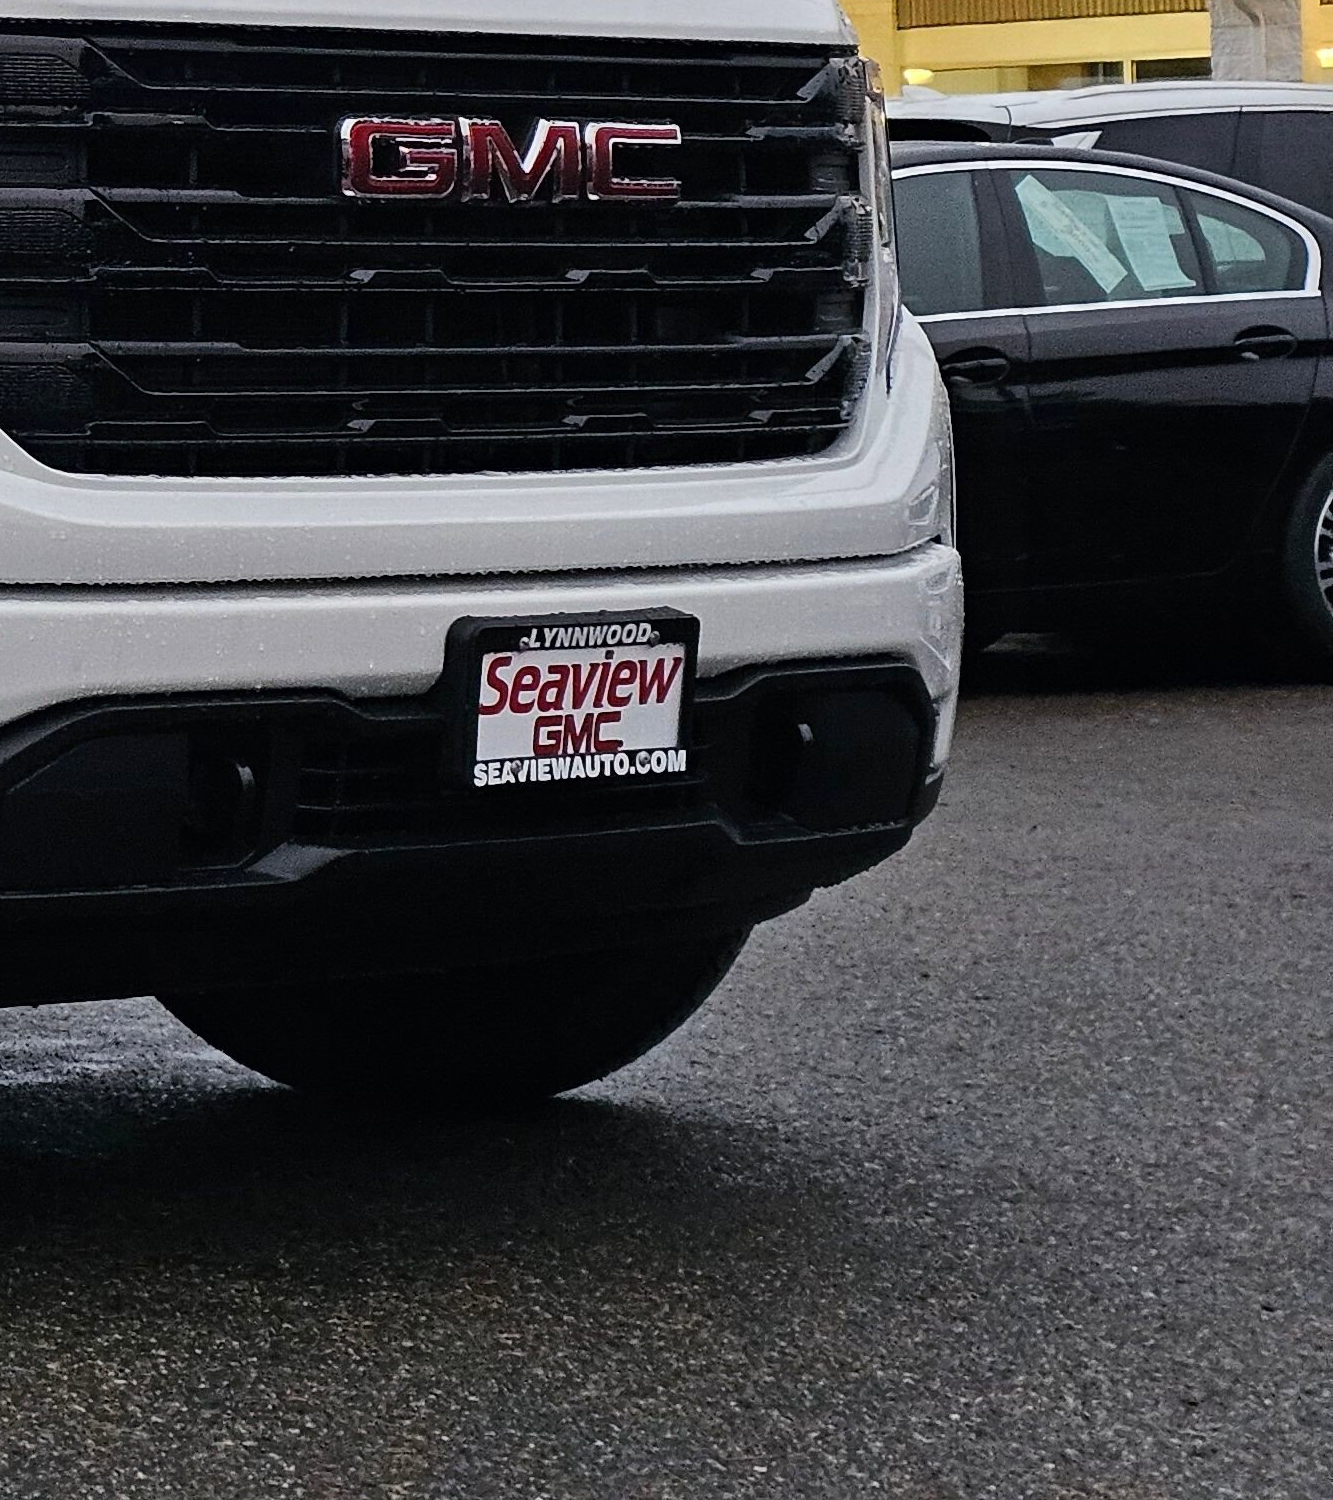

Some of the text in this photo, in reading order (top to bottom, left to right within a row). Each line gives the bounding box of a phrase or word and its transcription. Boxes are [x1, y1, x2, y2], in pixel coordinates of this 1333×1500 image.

[339, 116, 682, 202] GMC
[528, 622, 652, 648] LYNNWOOD
[477, 649, 684, 716] Seaview
[533, 710, 624, 757] GMC
[473, 749, 687, 787] SEAVIEWAUTO.COM
